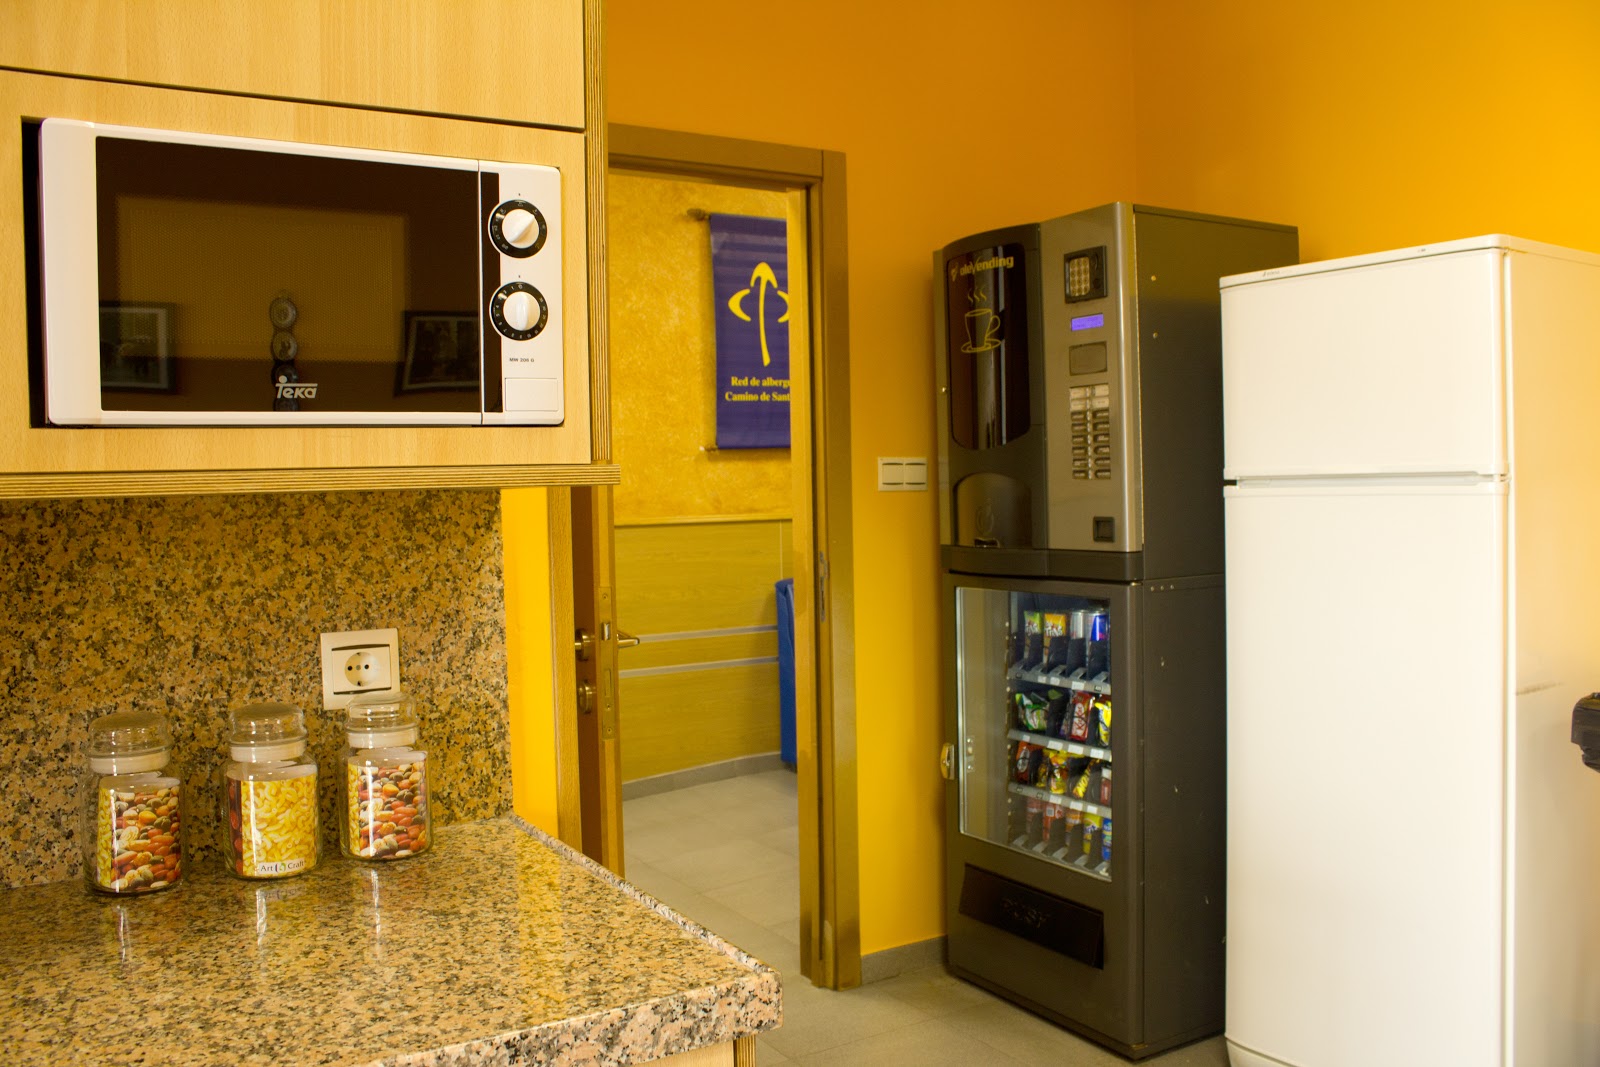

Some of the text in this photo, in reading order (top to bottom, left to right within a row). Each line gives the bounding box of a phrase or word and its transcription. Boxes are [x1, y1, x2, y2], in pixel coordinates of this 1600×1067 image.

[731, 376, 749, 387] Red
[750, 377, 761, 387] de
[725, 391, 790, 402] Camino de Sant
[287, 861, 304, 869] Craft
